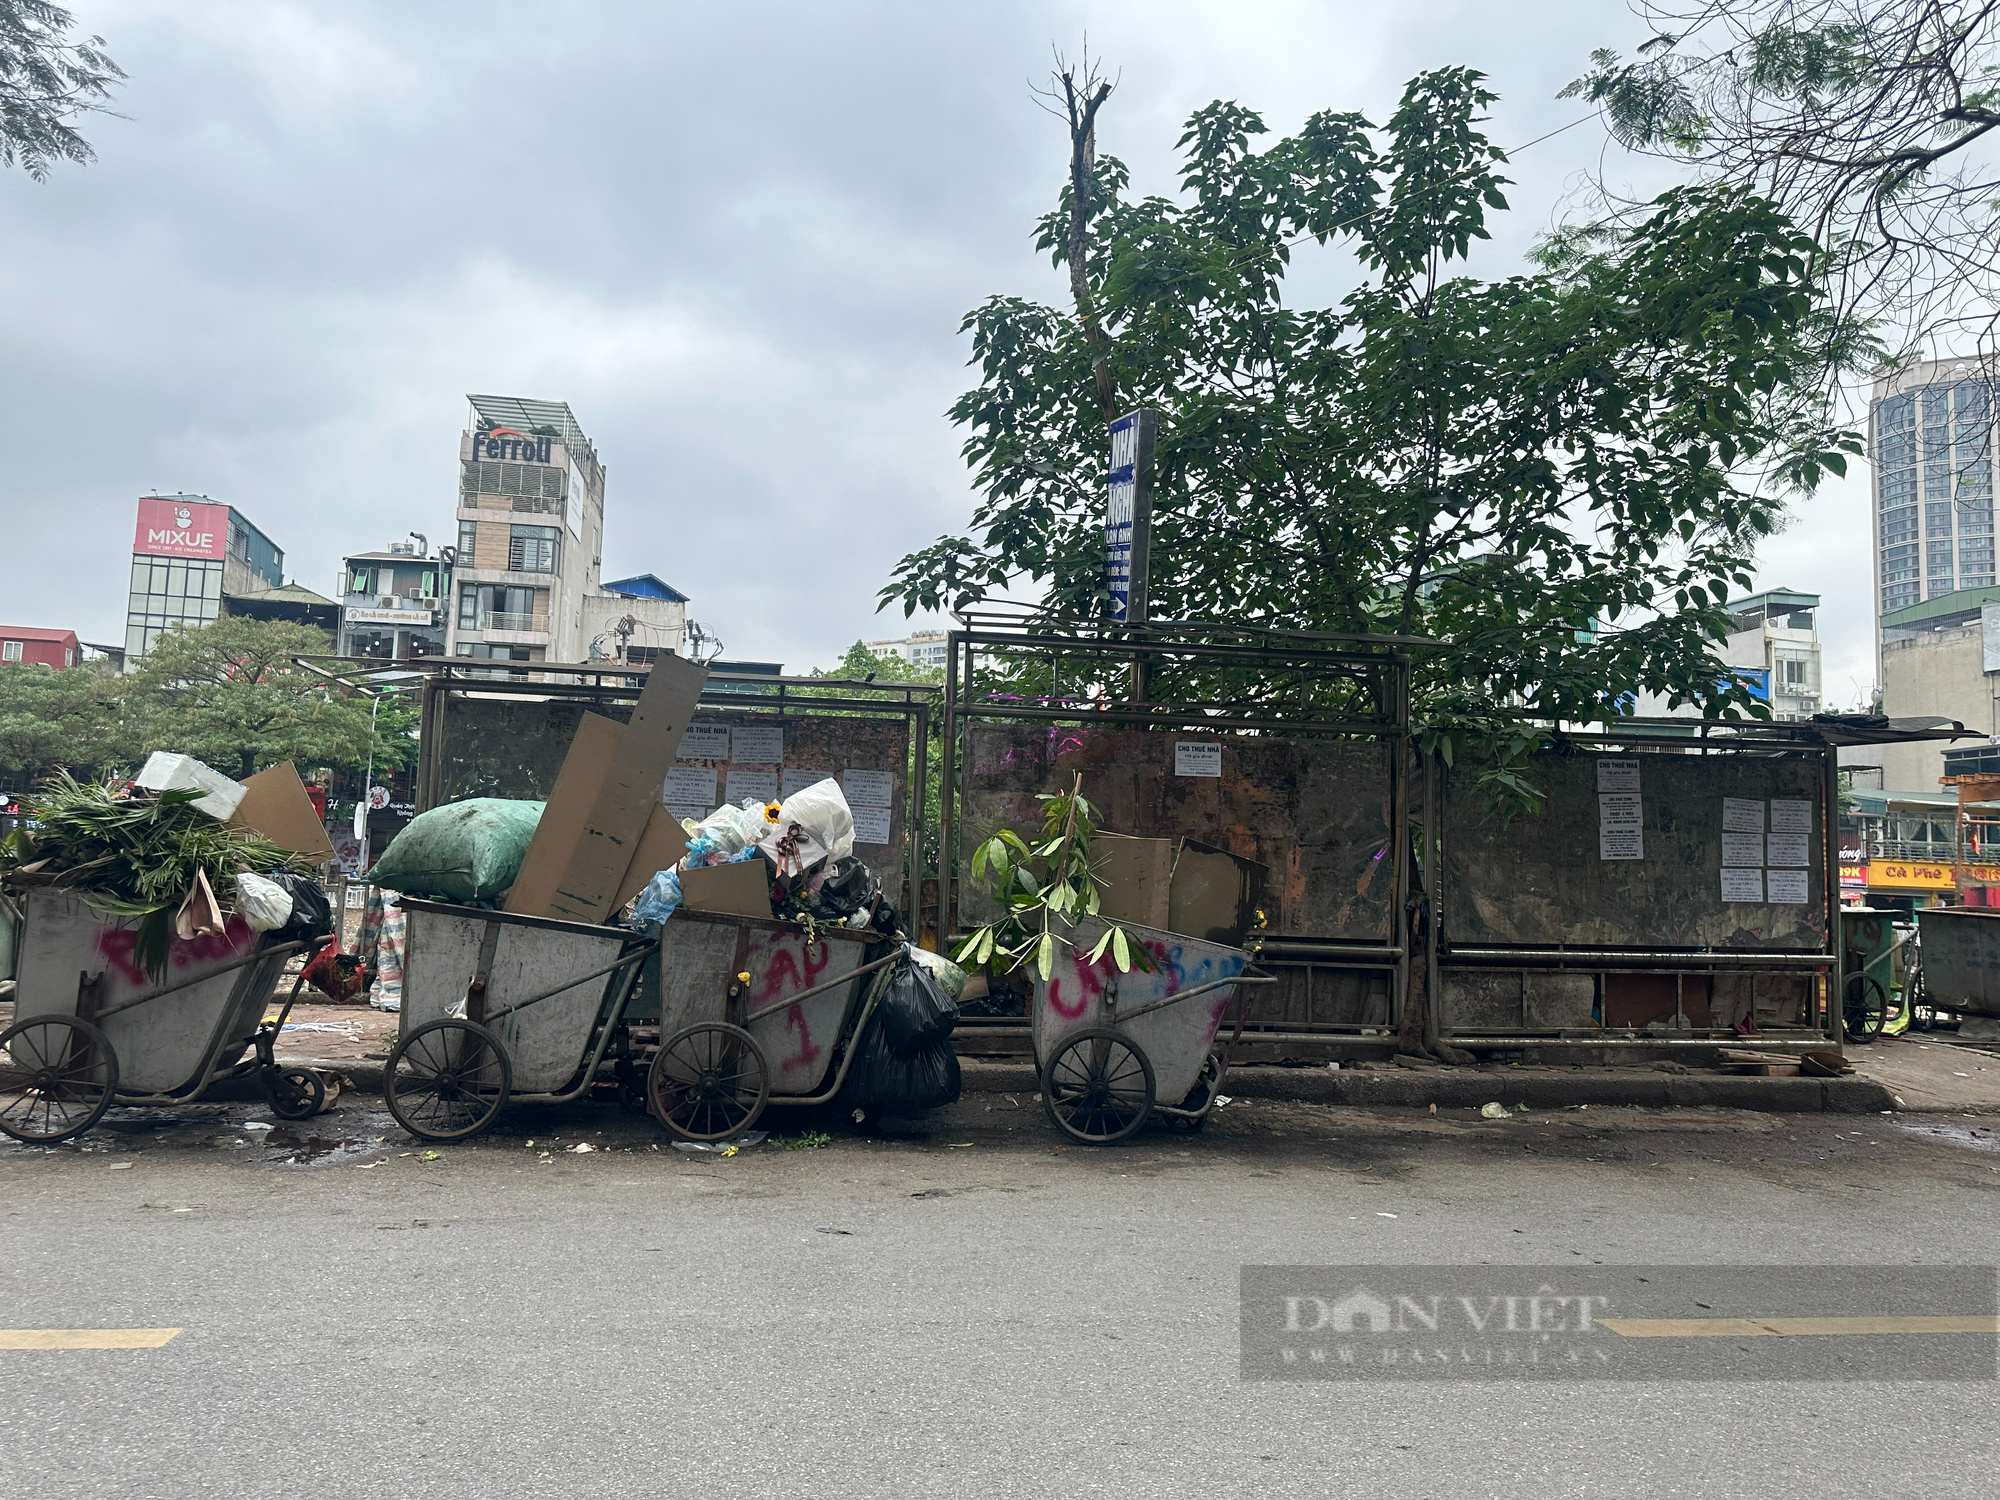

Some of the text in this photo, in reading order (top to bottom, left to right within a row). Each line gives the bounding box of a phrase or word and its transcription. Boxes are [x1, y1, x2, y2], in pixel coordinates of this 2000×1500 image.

[1112, 418, 1134, 470] NHÀ
[1108, 473, 1135, 524] NGHỈ
[148, 529, 214, 548] MIXUE
[1106, 527, 1131, 544] LAN ANH
[713, 726, 728, 735] NHÀ
[1886, 866, 1907, 878] Cà
[1913, 866, 1942, 879] Phê
